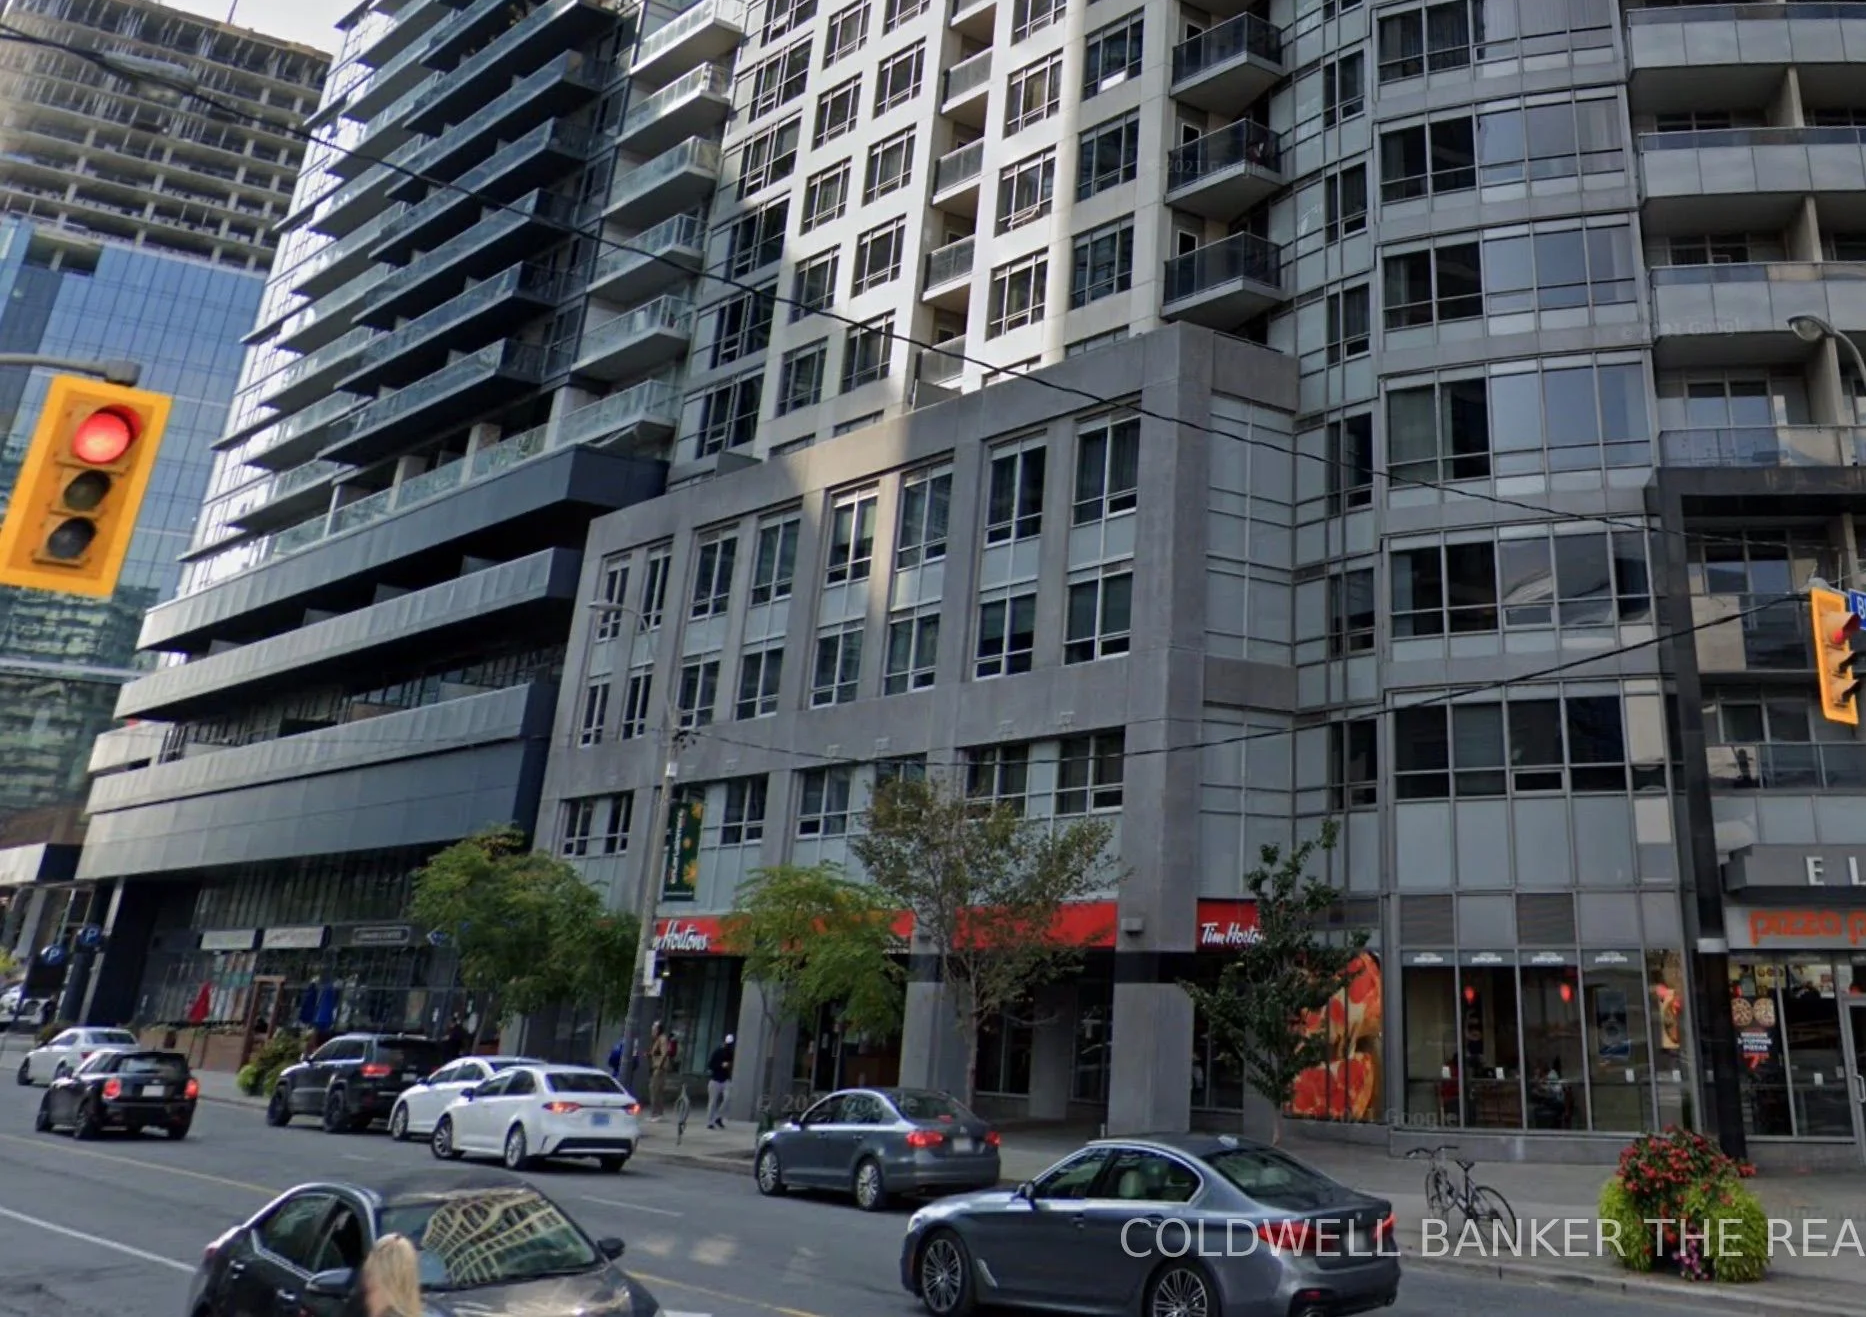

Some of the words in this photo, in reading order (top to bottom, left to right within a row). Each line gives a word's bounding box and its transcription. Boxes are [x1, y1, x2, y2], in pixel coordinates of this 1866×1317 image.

[662, 919, 710, 951] Hortons
[1201, 921, 1226, 945] Tim
[1749, 908, 1842, 946] pizza
